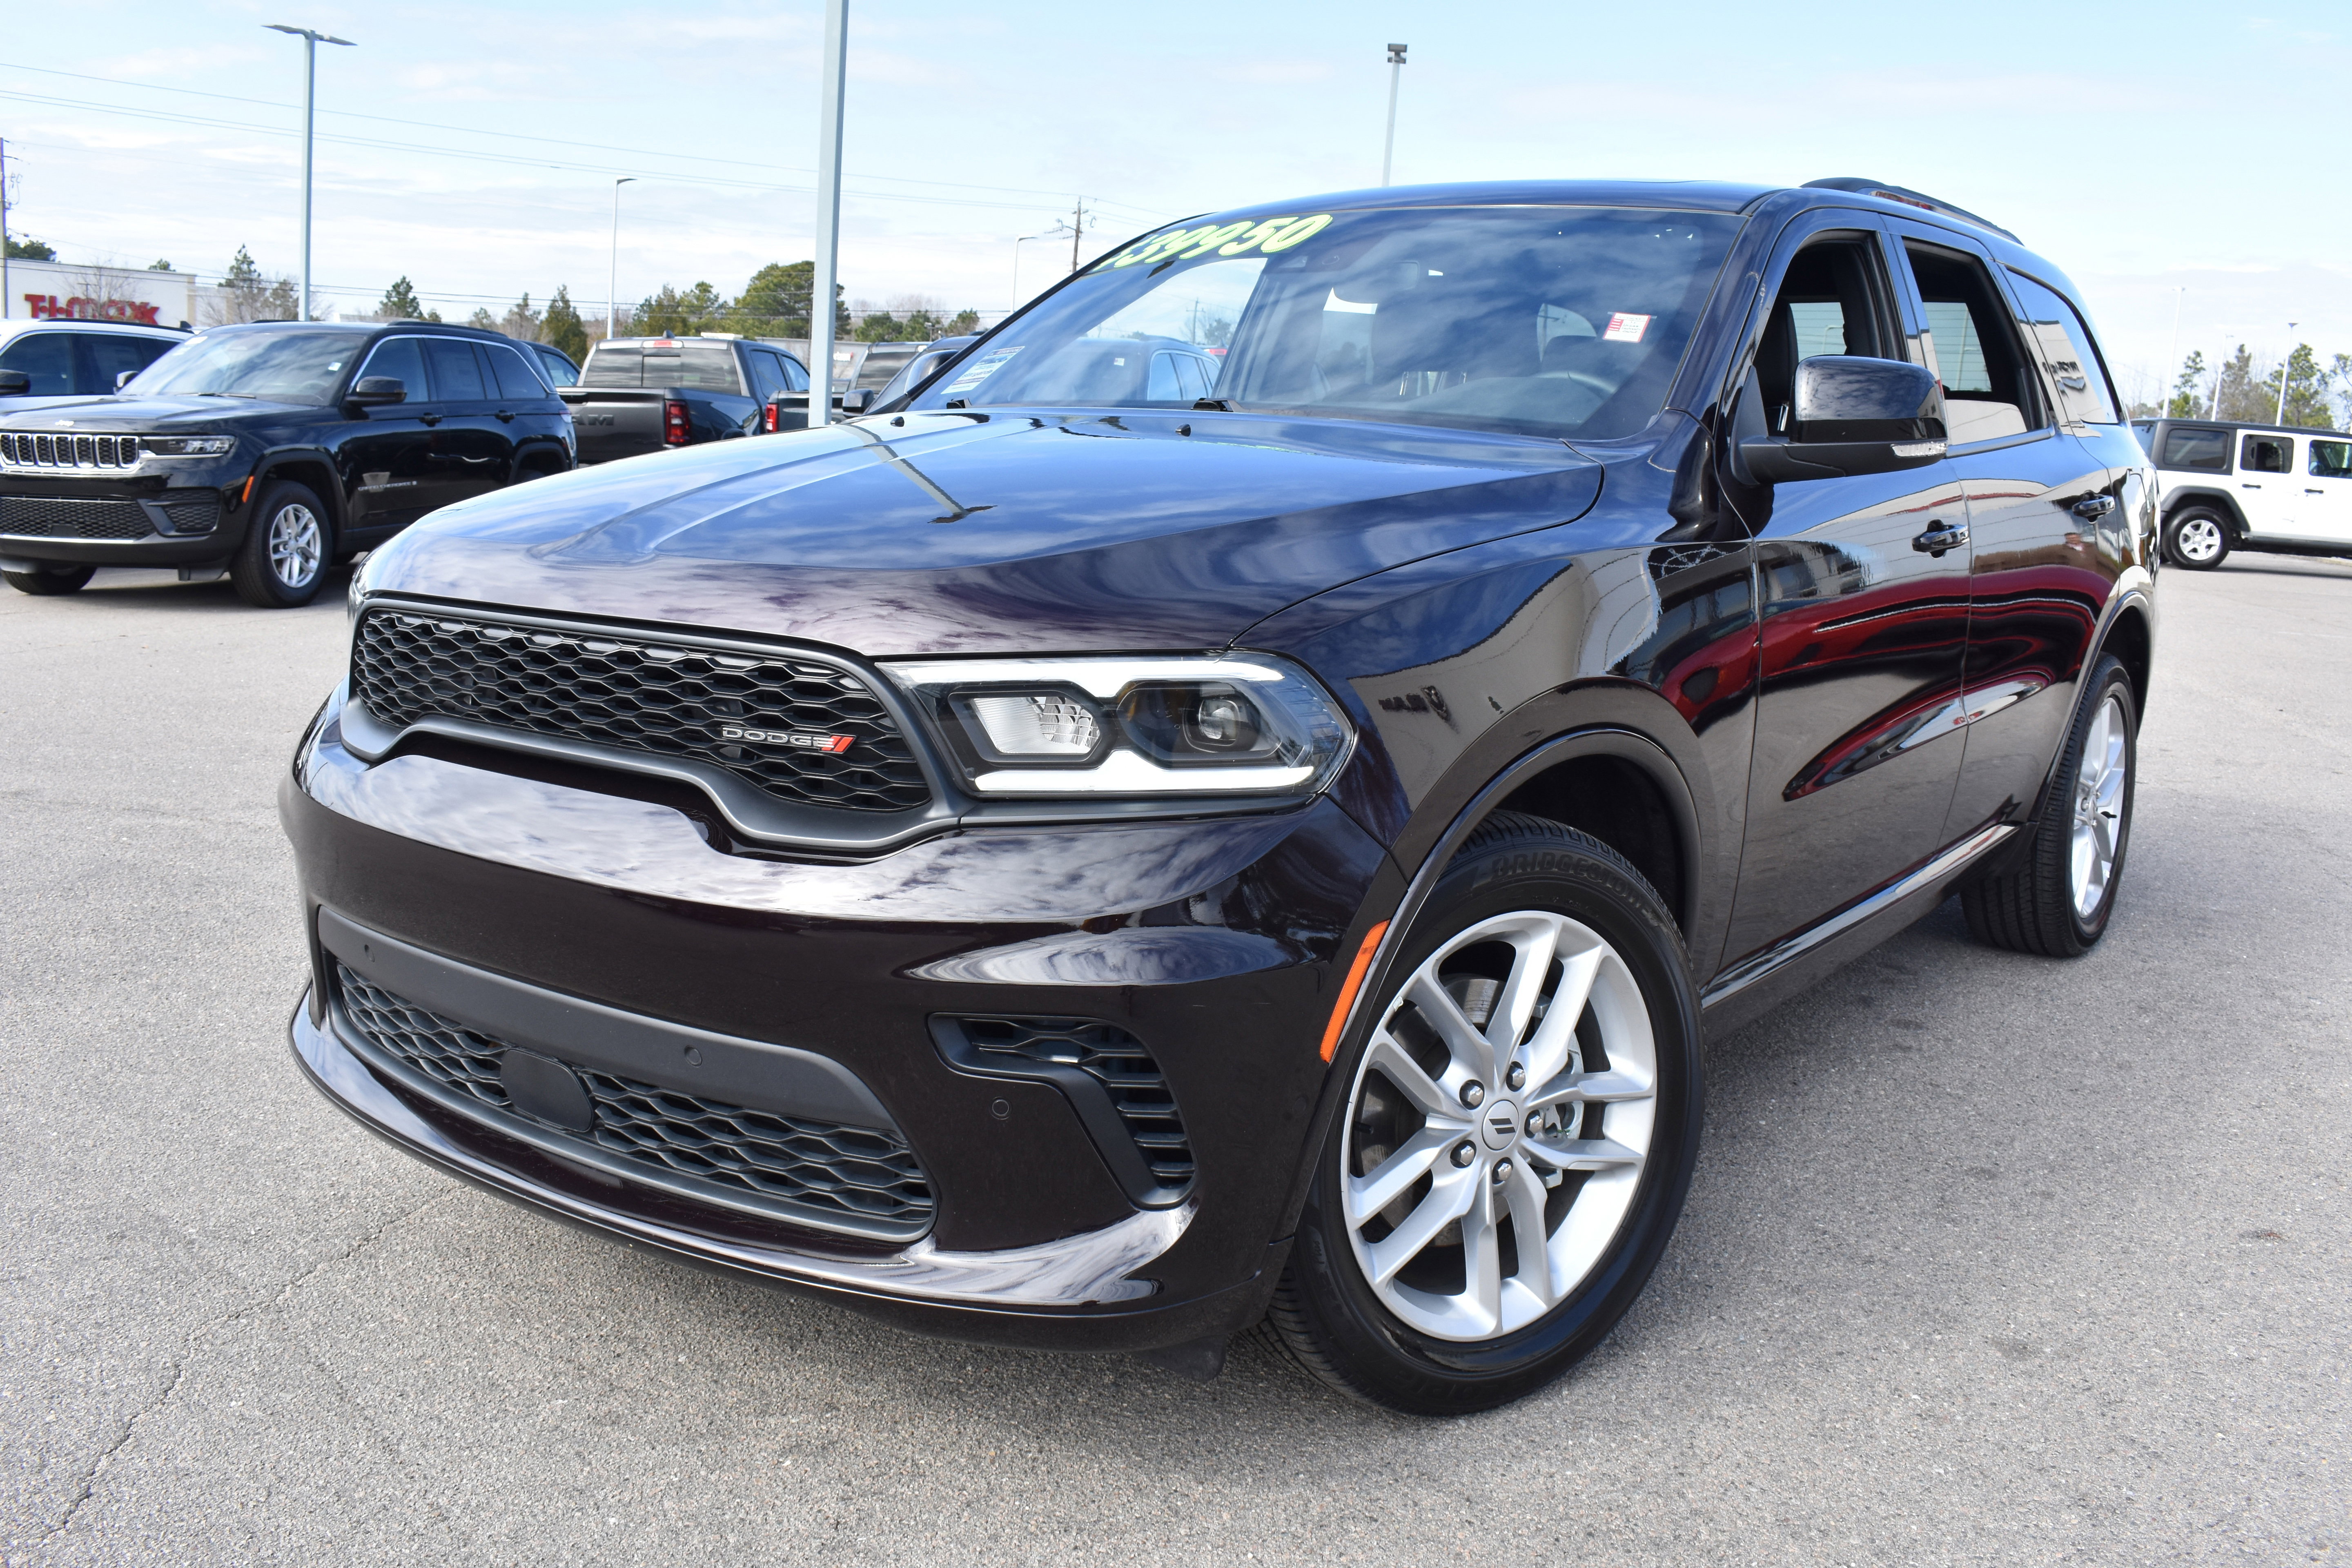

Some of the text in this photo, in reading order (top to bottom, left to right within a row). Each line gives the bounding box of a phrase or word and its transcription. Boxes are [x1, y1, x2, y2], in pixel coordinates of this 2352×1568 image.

[572, 414, 614, 425] AM
[722, 727, 834, 748] DODGE
[1491, 852, 1655, 920] BRIDGESTONE
